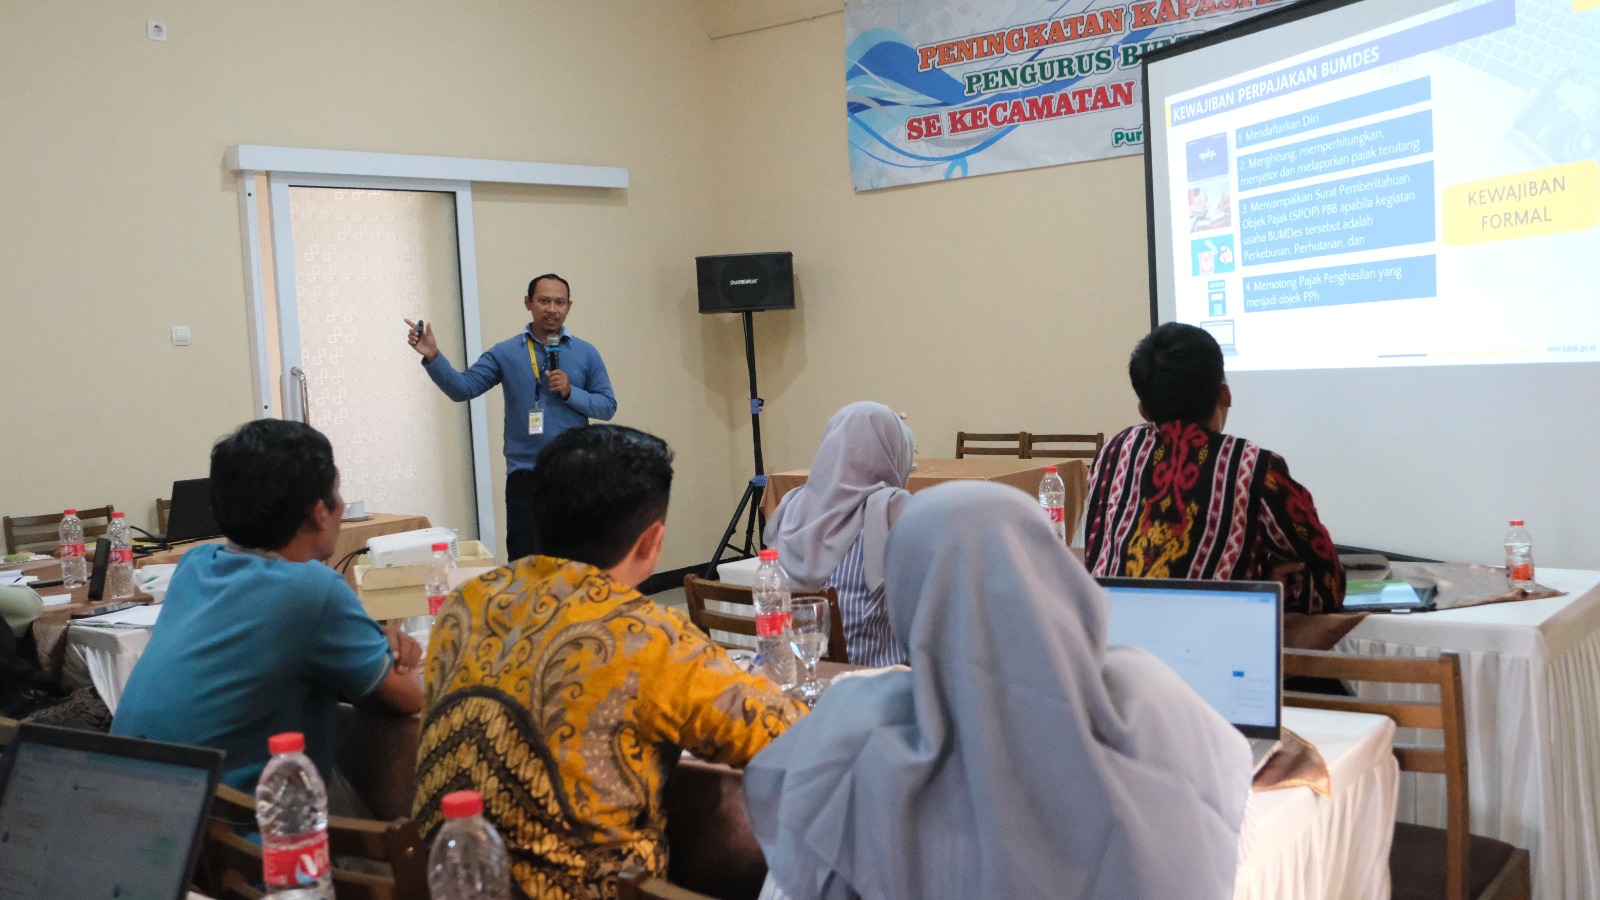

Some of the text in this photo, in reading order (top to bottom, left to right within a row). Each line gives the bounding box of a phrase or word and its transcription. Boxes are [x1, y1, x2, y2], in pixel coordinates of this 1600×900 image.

[918, 8, 1124, 70] PENINGKATAN
[1132, 0, 1287, 28] KAPA
[966, 48, 1112, 94] PENGURUS
[1173, 45, 1380, 122] KEWAJIBAN PERPAJAKAN BUMDES
[906, 81, 1135, 141] SE KECAMATAN
[1245, 120, 1301, 142] Mendaftarkan
[1302, 112, 1319, 127] Diri
[1240, 139, 1421, 187] menyetor dan melaporkan pajak terutang
[1248, 151, 1298, 168] Menghitung,
[1250, 193, 1313, 213] Menyampaikan
[1315, 187, 1337, 201] Surat
[1339, 174, 1410, 196] Pemberitahuan
[1467, 175, 1567, 207] KEWAJIBAN
[1242, 191, 1416, 231] Objek Pajak (SPOP) PBB apabila kegiatan
[1481, 206, 1553, 231] FORMAL
[1243, 214, 1373, 245] usaha BUMDes tersebut adalah
[1347, 234, 1365, 247] dan
[1254, 279, 1297, 292] Memotong
[1299, 274, 1322, 289] Pajak
[1323, 268, 1376, 286] Penghasilan
[1377, 266, 1403, 281] yang
[1246, 290, 1320, 309] menjadi objek PPh
